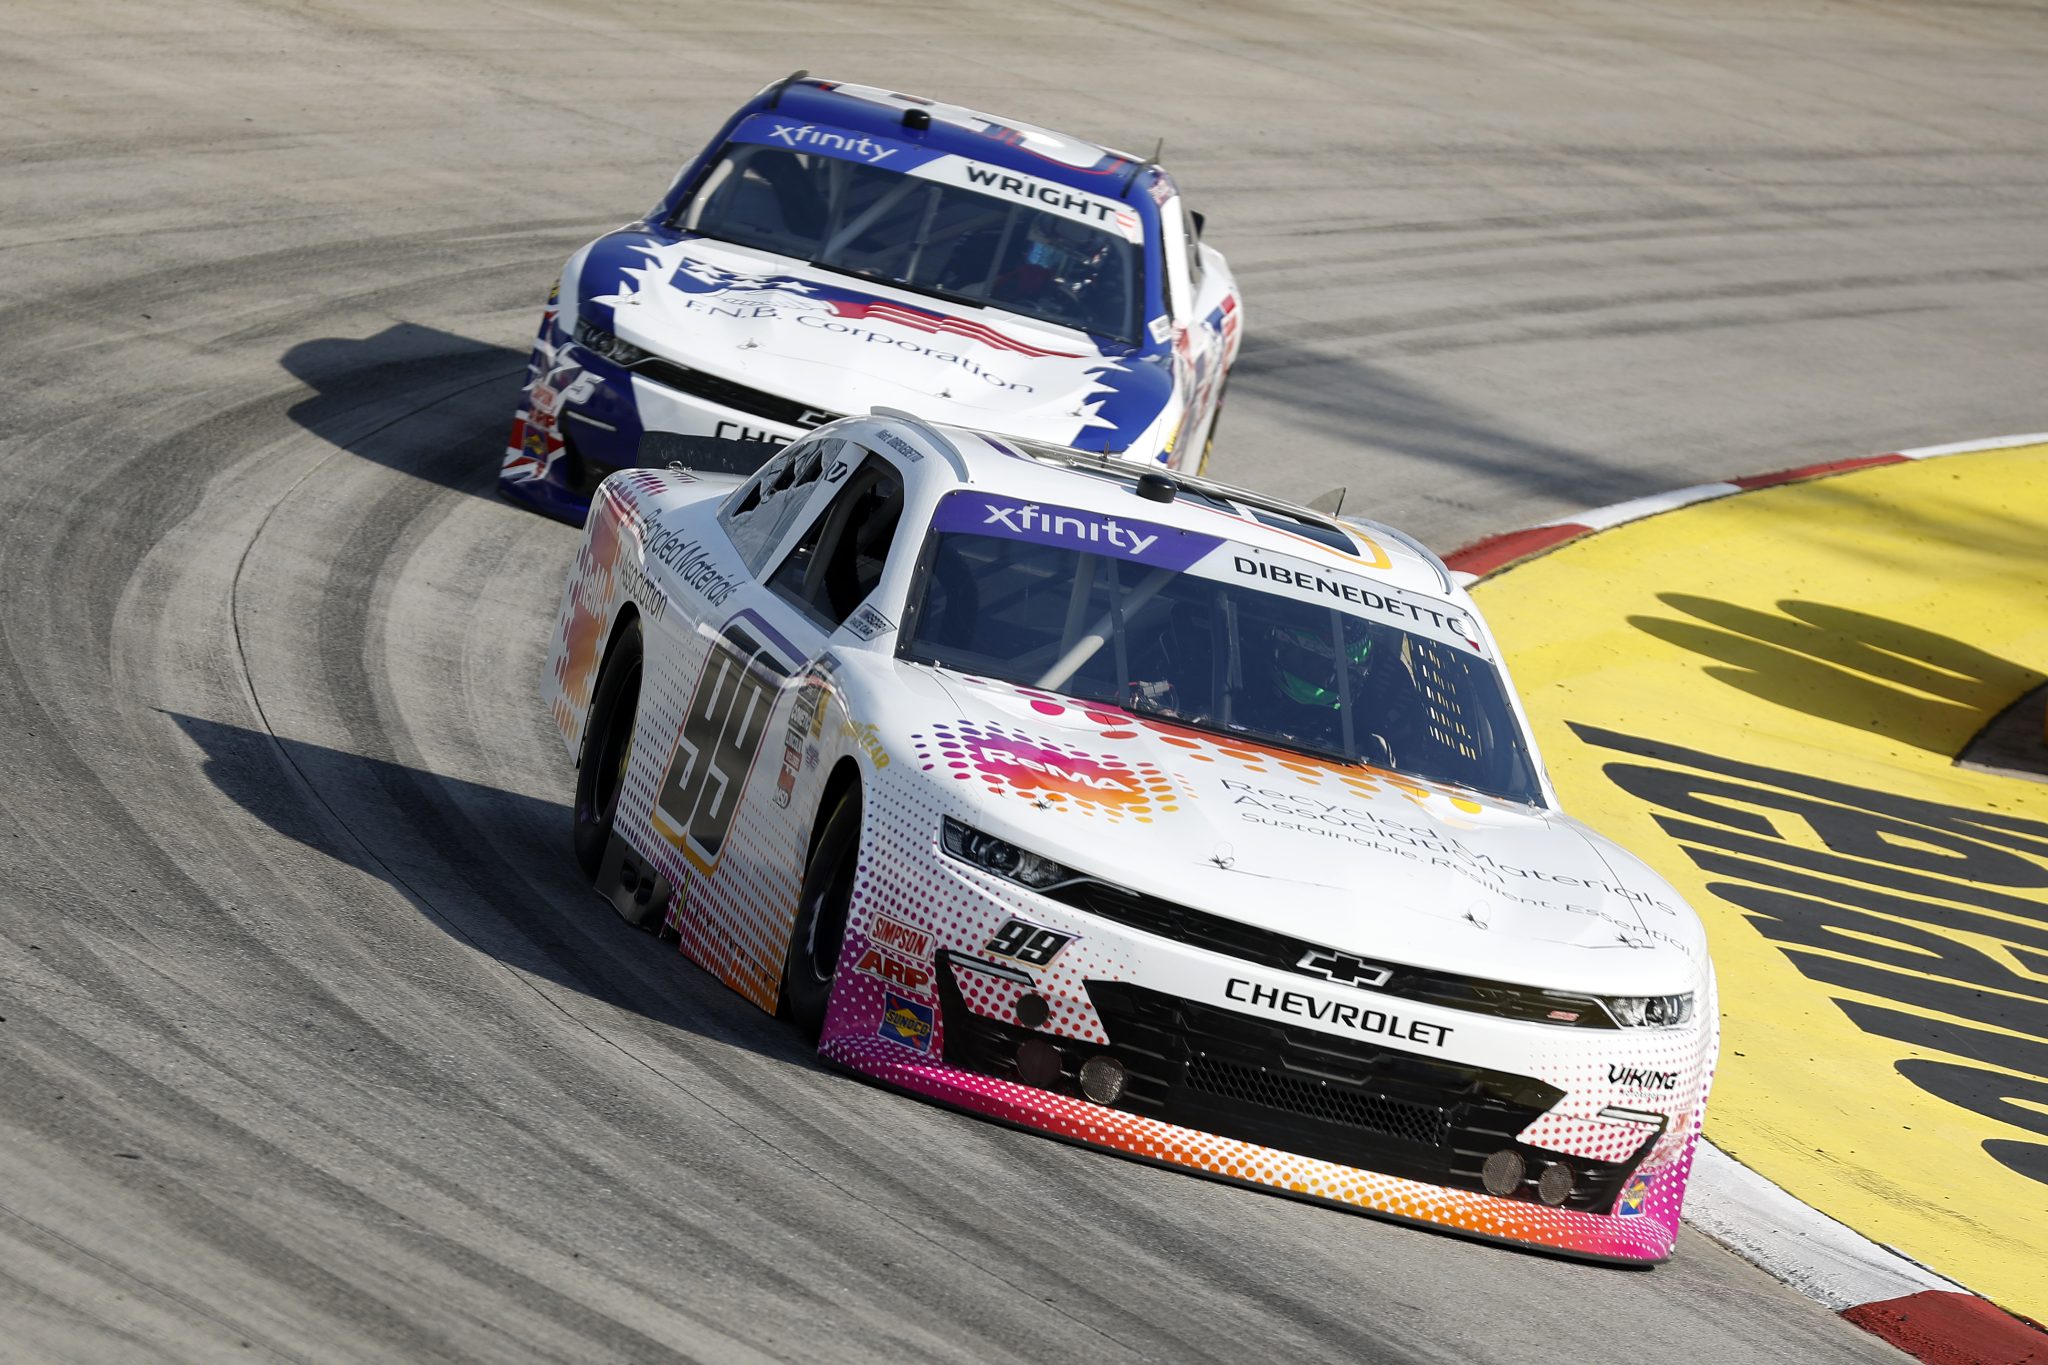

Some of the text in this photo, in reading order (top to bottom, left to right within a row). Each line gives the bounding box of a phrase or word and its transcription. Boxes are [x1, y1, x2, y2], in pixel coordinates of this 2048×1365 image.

[768, 124, 899, 162] xfinity
[967, 165, 1116, 222] WRIGHT
[796, 315, 1036, 394] Corporation
[639, 508, 746, 607] Recycled Materials
[983, 504, 1159, 555] xfinity
[619, 548, 668, 623] Association
[1234, 556, 1466, 639] DIBENEDETTO
[656, 622, 797, 860] 99
[979, 746, 1135, 793] ReMA
[1220, 778, 1677, 917] Recycled Materials
[1233, 794, 1505, 885] Association
[872, 916, 930, 958] SIMPSON
[983, 920, 1074, 966] 99
[857, 950, 930, 989] ARP
[886, 1011, 930, 1036] SUNOCO
[1225, 978, 1455, 1048] CHEVROLET
[1608, 1063, 1679, 1090] VIKING
